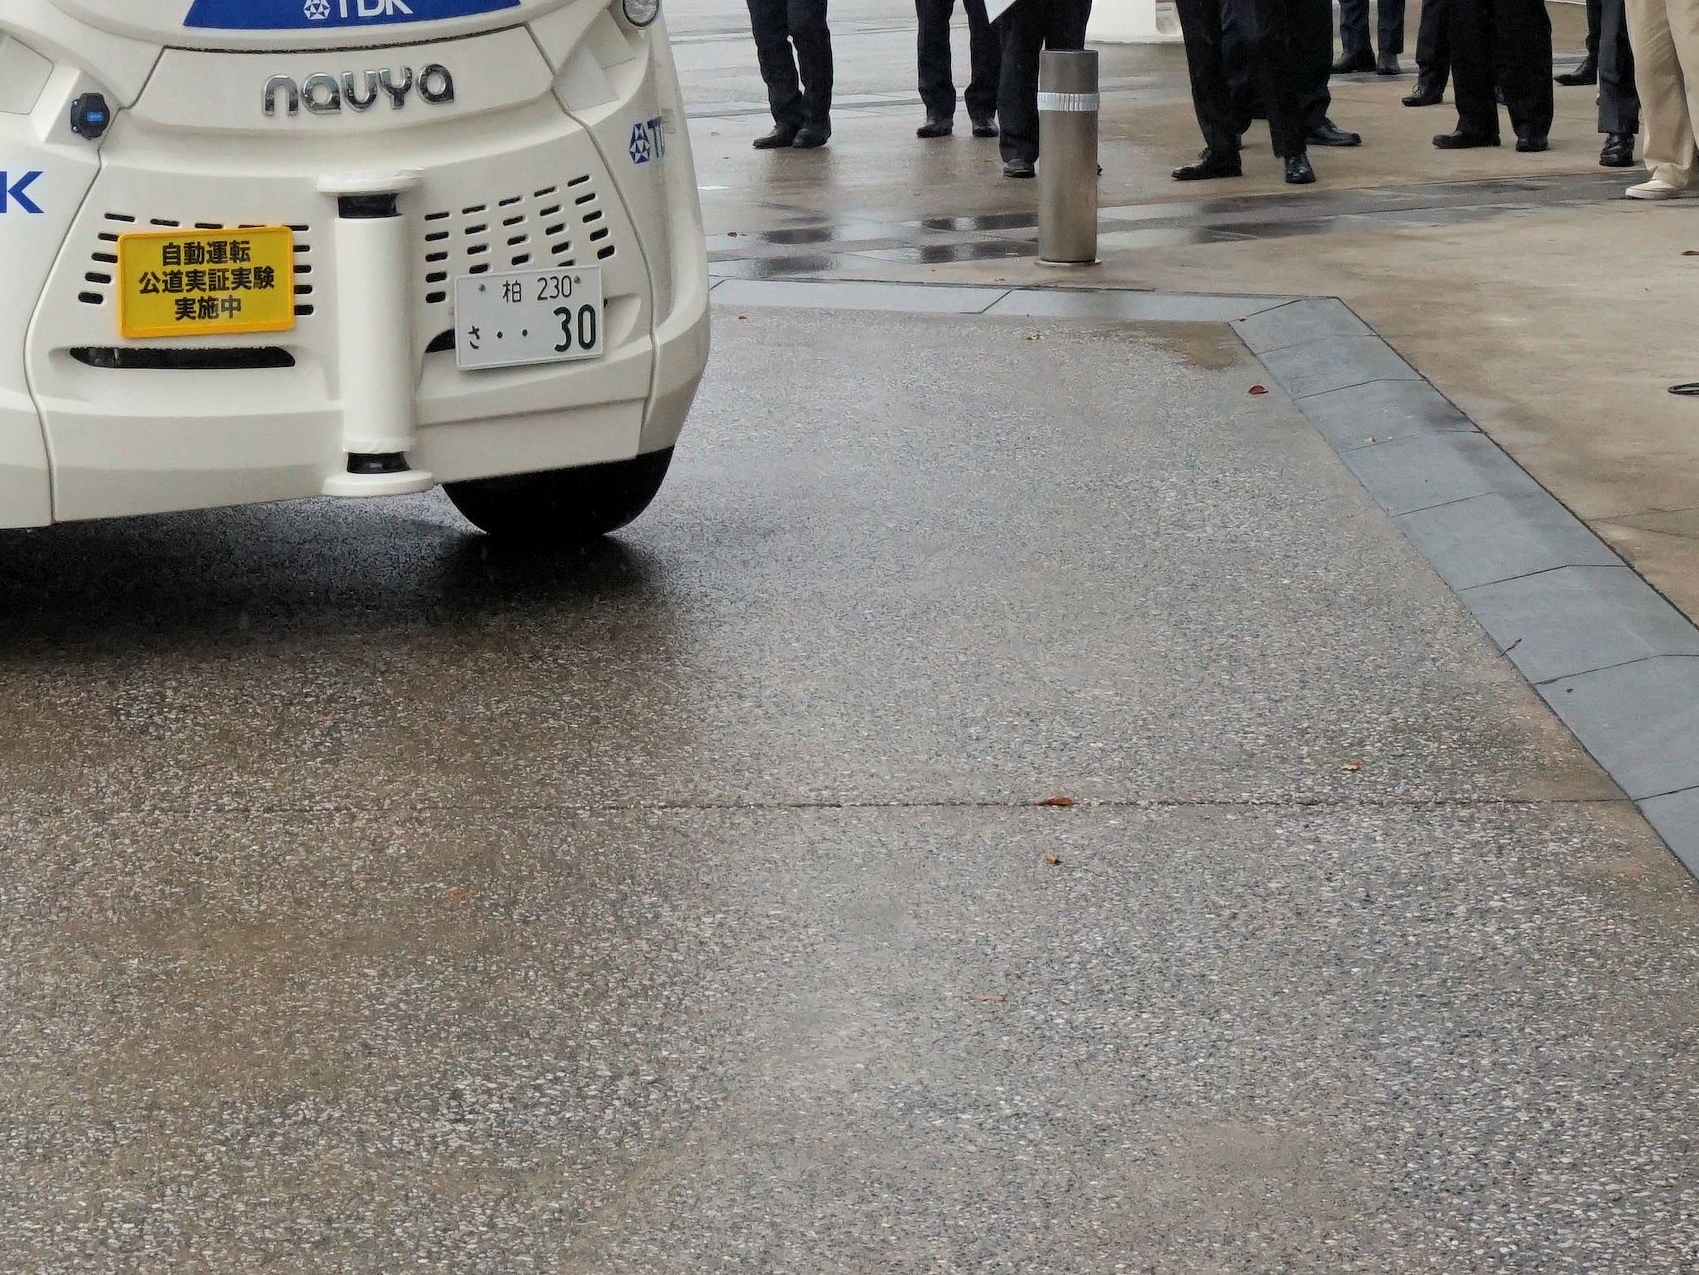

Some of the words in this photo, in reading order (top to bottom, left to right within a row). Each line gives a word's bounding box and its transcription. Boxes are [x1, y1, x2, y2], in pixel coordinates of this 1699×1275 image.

[162, 239, 251, 267] 自動運転
[138, 266, 275, 295] 公道実証実験
[502, 279, 522, 303] 柏
[536, 275, 572, 301] 230
[174, 294, 242, 321] 実施中
[468, 325, 481, 350] さ
